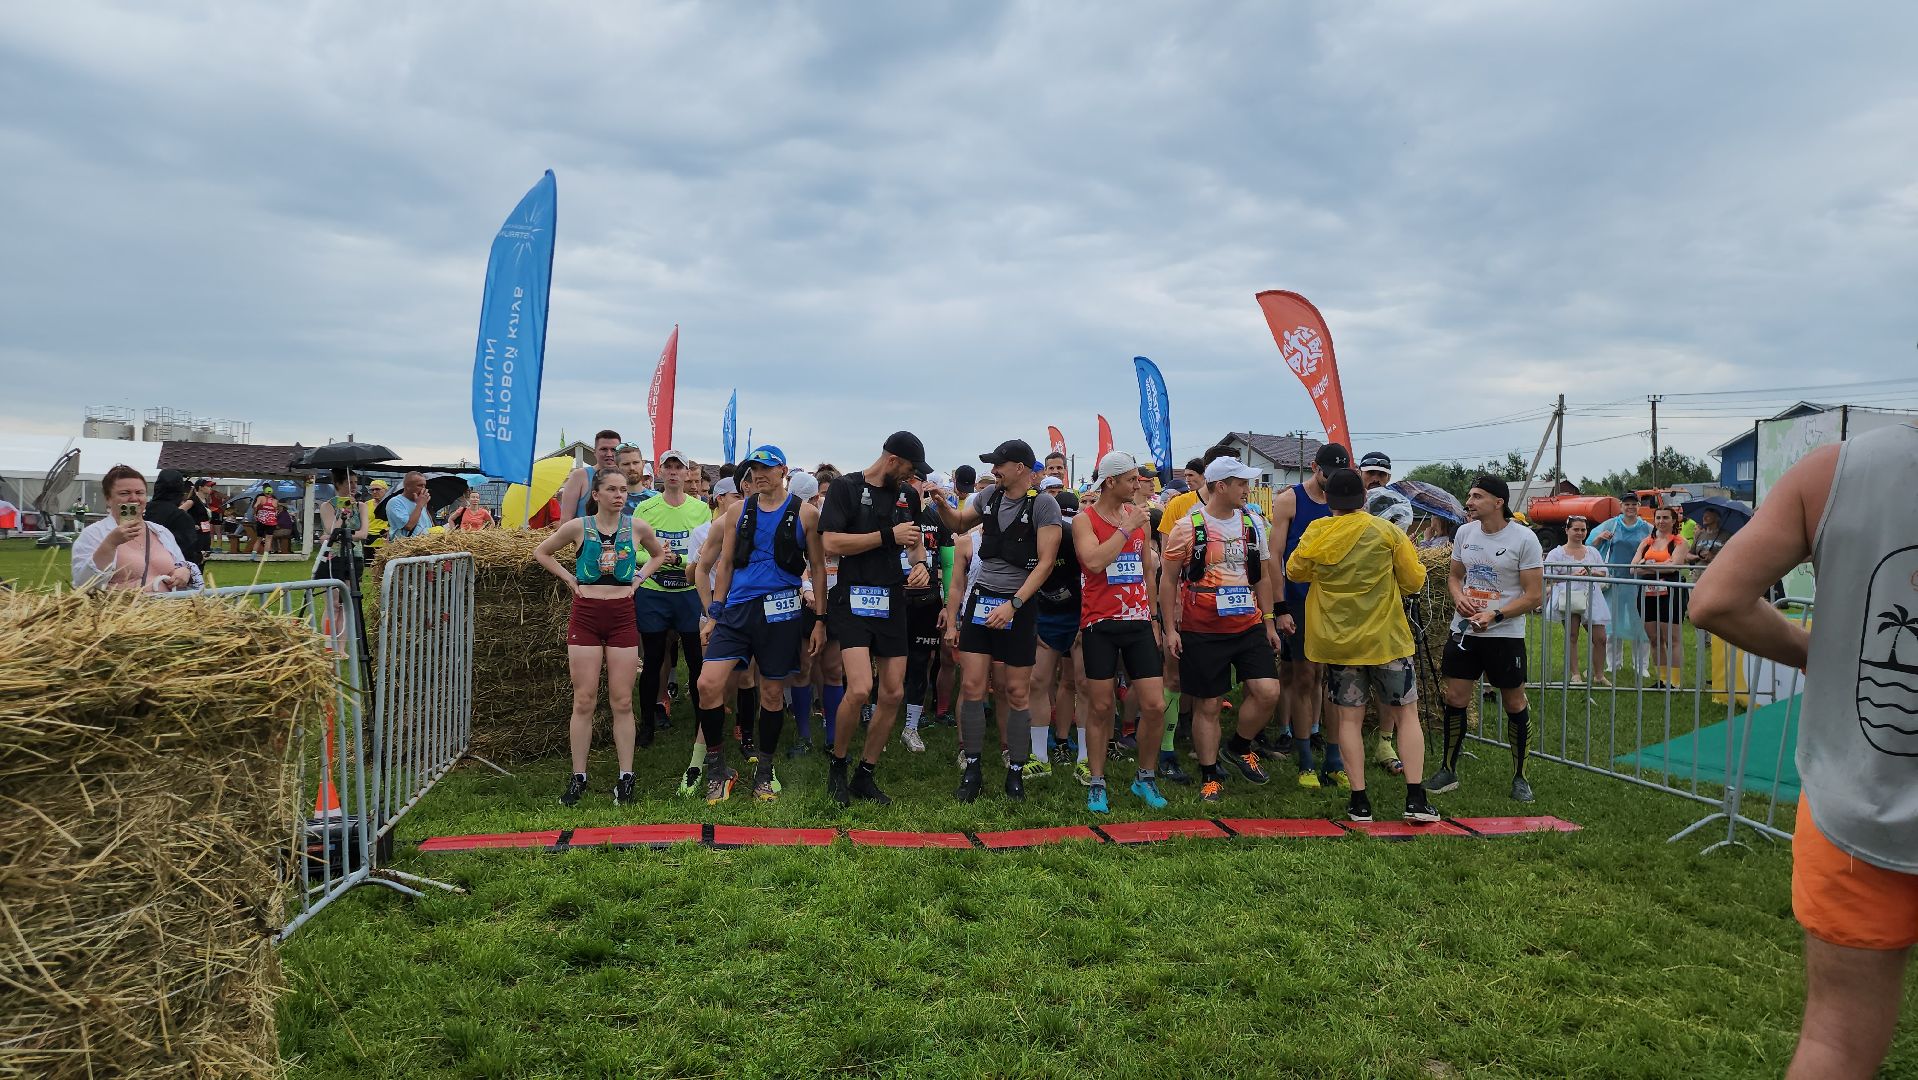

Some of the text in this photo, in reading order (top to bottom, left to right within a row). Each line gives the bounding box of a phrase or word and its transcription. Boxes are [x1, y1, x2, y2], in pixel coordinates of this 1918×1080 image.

[1116, 562, 1136, 572] 919
[775, 598, 795, 611] 915
[861, 596, 881, 606] 947
[1227, 594, 1247, 605] 937
